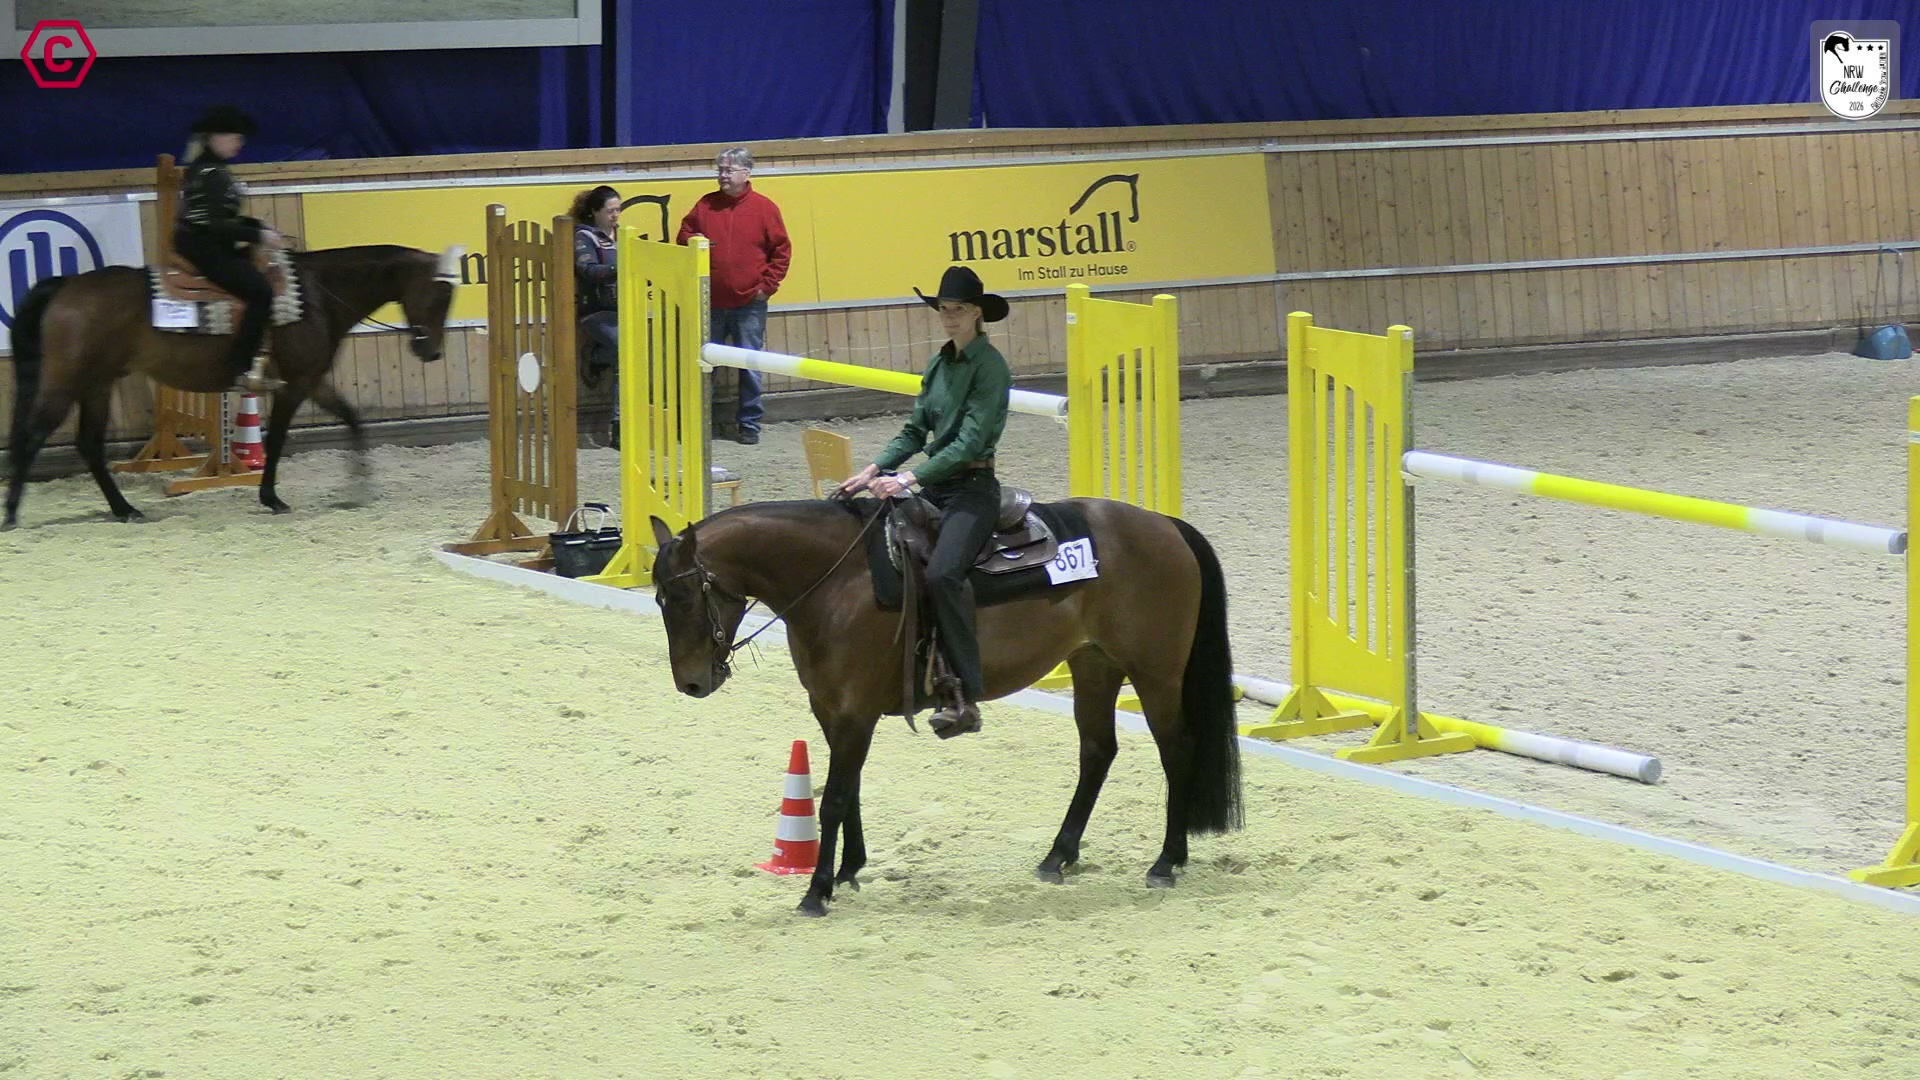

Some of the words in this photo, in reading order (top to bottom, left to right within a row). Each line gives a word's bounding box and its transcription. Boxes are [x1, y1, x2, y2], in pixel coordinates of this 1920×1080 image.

[948, 210, 1125, 262] marstall
[1018, 268, 1034, 281] Im
[1038, 265, 1066, 279] Stall
[1070, 267, 1084, 278] zu
[1088, 263, 1129, 277] Hause
[1055, 544, 1086, 572] 867
